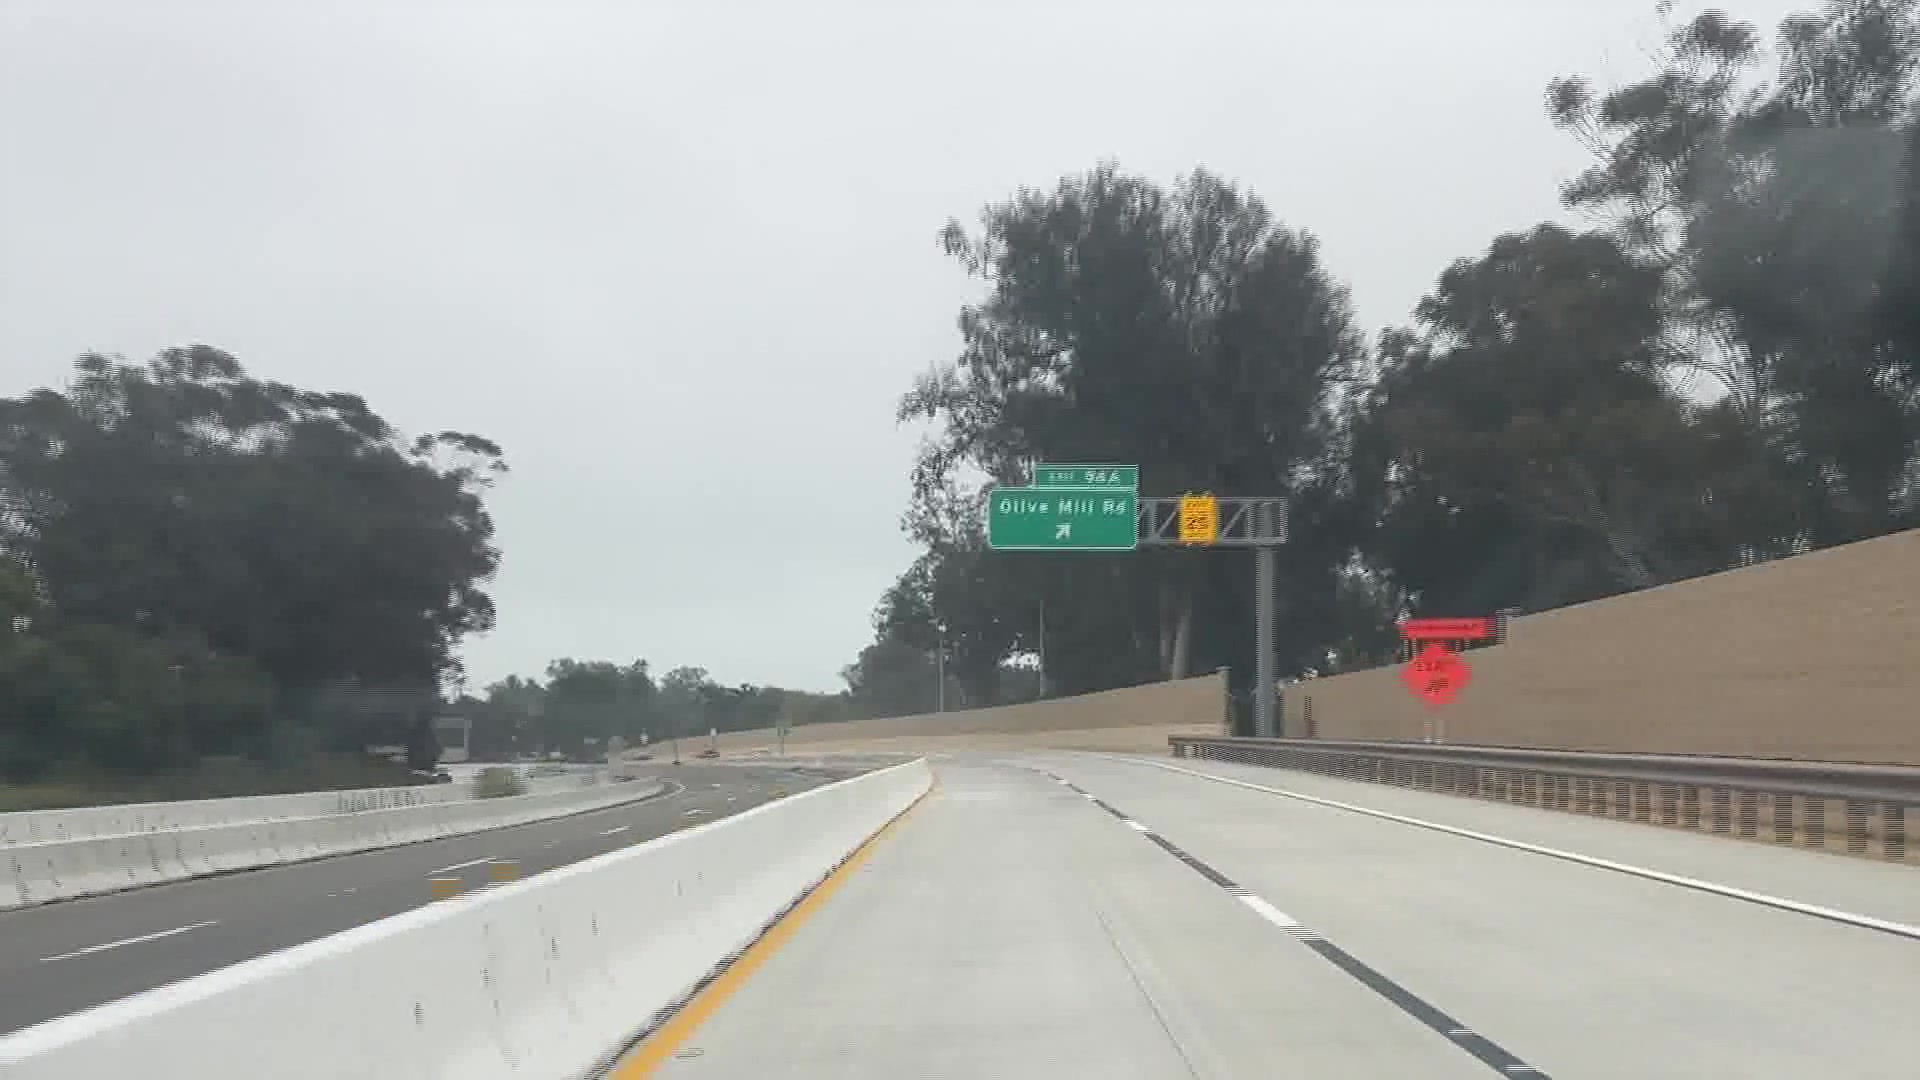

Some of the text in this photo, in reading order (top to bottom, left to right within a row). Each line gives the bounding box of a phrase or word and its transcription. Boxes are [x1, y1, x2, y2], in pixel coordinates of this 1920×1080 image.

[999, 499, 1127, 514] Olive Mill Rd
